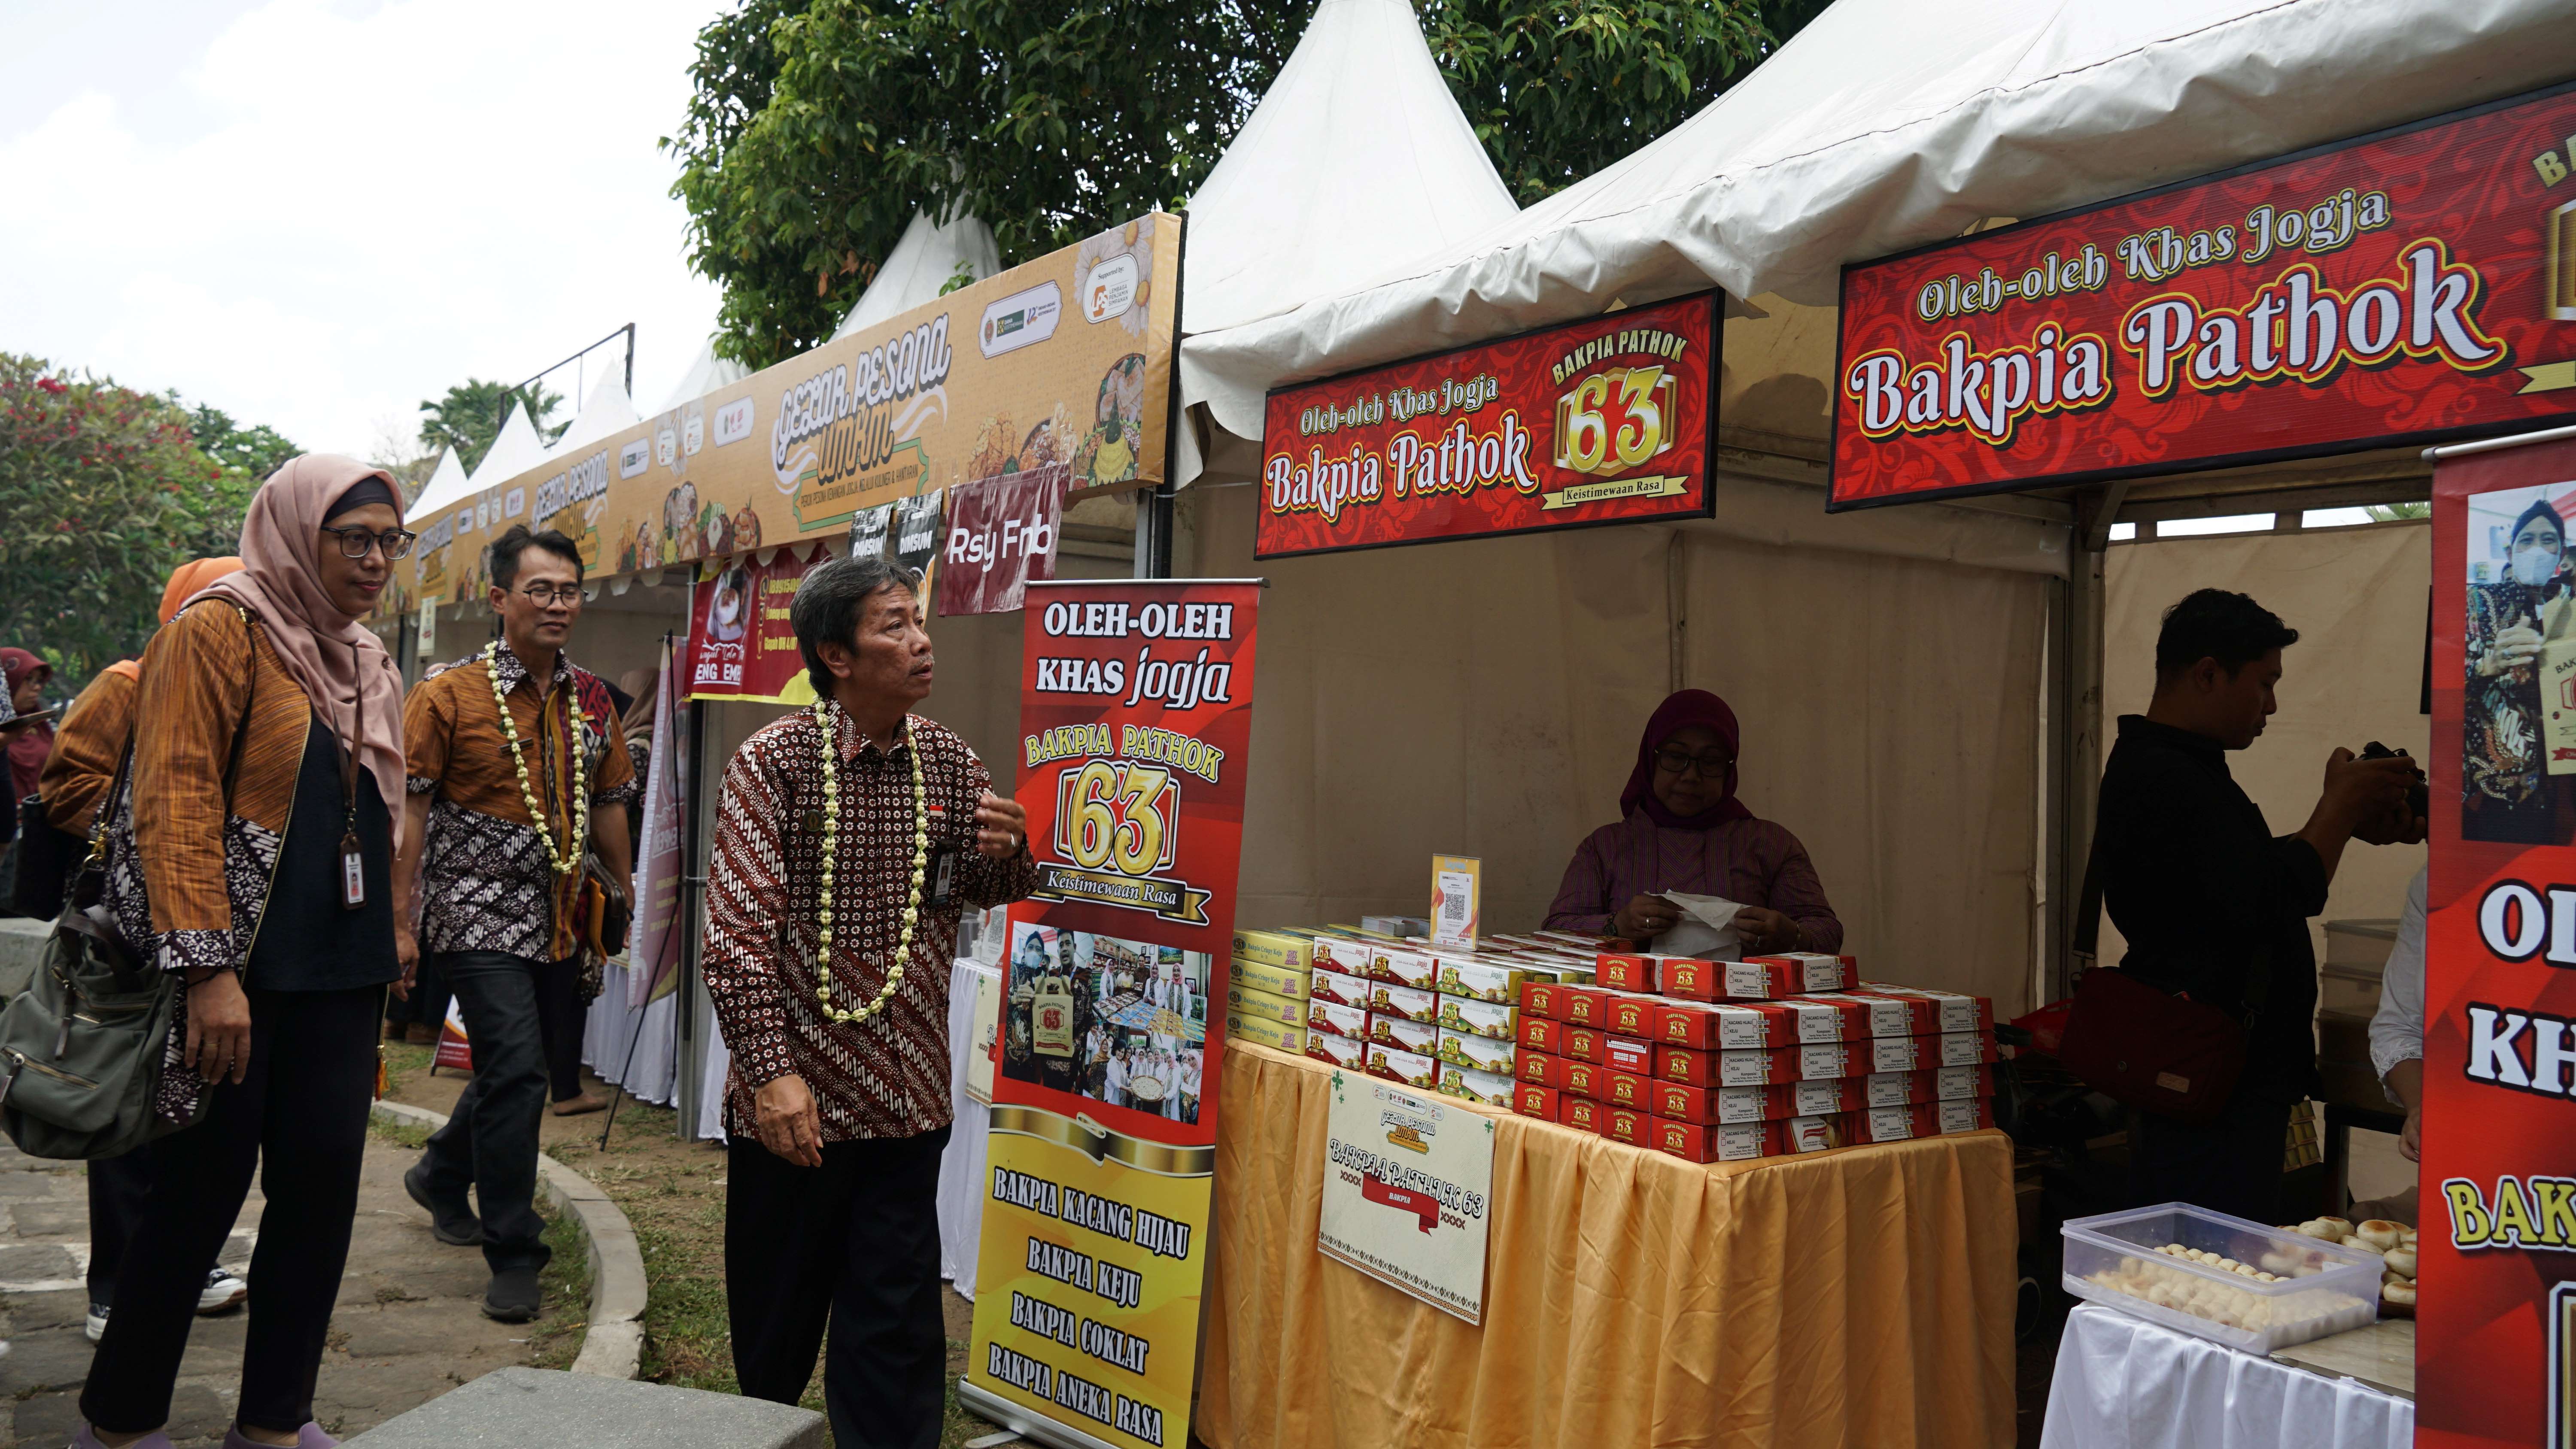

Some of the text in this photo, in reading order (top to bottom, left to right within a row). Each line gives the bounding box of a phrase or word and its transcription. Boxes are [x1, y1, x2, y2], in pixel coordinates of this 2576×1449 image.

[1919, 190, 2388, 319] Oleh-oleh Khas Jogja
[1098, 267, 1117, 279] Supported
[1109, 284, 1128, 294] LEMBAGA
[1109, 290, 1128, 300] PENJAMIN
[1108, 295, 1128, 306] SIMPANAN
[1847, 241, 2501, 440] Bakpia Pathok
[1552, 329, 1688, 386] BAKPIA PATHOK
[1302, 373, 1498, 434] Oleh-oleh Khas Jogja
[1566, 365, 1664, 473] 63
[817, 400, 894, 485] UMKM
[896, 464, 918, 482] HANTARAN
[1266, 411, 1537, 521] Bakpia Pathok
[1566, 481, 1660, 500] Keistimewaan Rasa
[853, 535, 884, 558] DIMSUM
[899, 530, 933, 555] DIMSUM
[948, 513, 1052, 573] Rsy Fnb
[1044, 602, 1233, 639] OLEH-OLEH
[695, 663, 718, 681] ENG
[1036, 646, 1232, 710] KHAS jogja
[1025, 724, 1223, 782] BAKPIA PATHOK
[1069, 761, 1169, 876] 63
[1046, 870, 1177, 906] Keistimewaan Rasa
[1248, 943, 1260, 952] Bakpia
[1261, 946, 1273, 955] Crispy
[1273, 949, 1282, 957] Keju
[1377, 957, 1387, 972] 63
[1416, 959, 1428, 968] jogja
[1610, 966, 1624, 981] 63
[1245, 970, 1280, 985] Bakpia Crispy Keju
[1490, 970, 1503, 979] jogja
[1677, 970, 1693, 985] 63
[1243, 996, 1279, 1012] Bakpia Crispy Keju
[1377, 989, 1428, 1004] 63 jogja
[1044, 1009, 1061, 1030] 63
[1491, 1006, 1504, 1016] jogja
[1621, 1011, 1637, 1026] 63
[1243, 1023, 1279, 1039] Bakpia Crispy Keju
[1378, 1022, 1431, 1036] 63 jogja
[1669, 1021, 1686, 1037] 63
[1494, 1041, 1507, 1052] jogja
[1374, 1052, 1427, 1067] 63 jogja
[1497, 1076, 1511, 1086] jogja
[1330, 1139, 1484, 1219] BAKPIA PATHUK 63
[1388, 1192, 1411, 1204] BAKPIA
[993, 1166, 1191, 1261] BAKPIA KACANG HIJAU
[1027, 1236, 1142, 1308] BAKPIA KEJU
[1011, 1290, 1149, 1376] BAKPIA COKLAT
[987, 1341, 1163, 1448] BAKPIA ANEKA RASA
